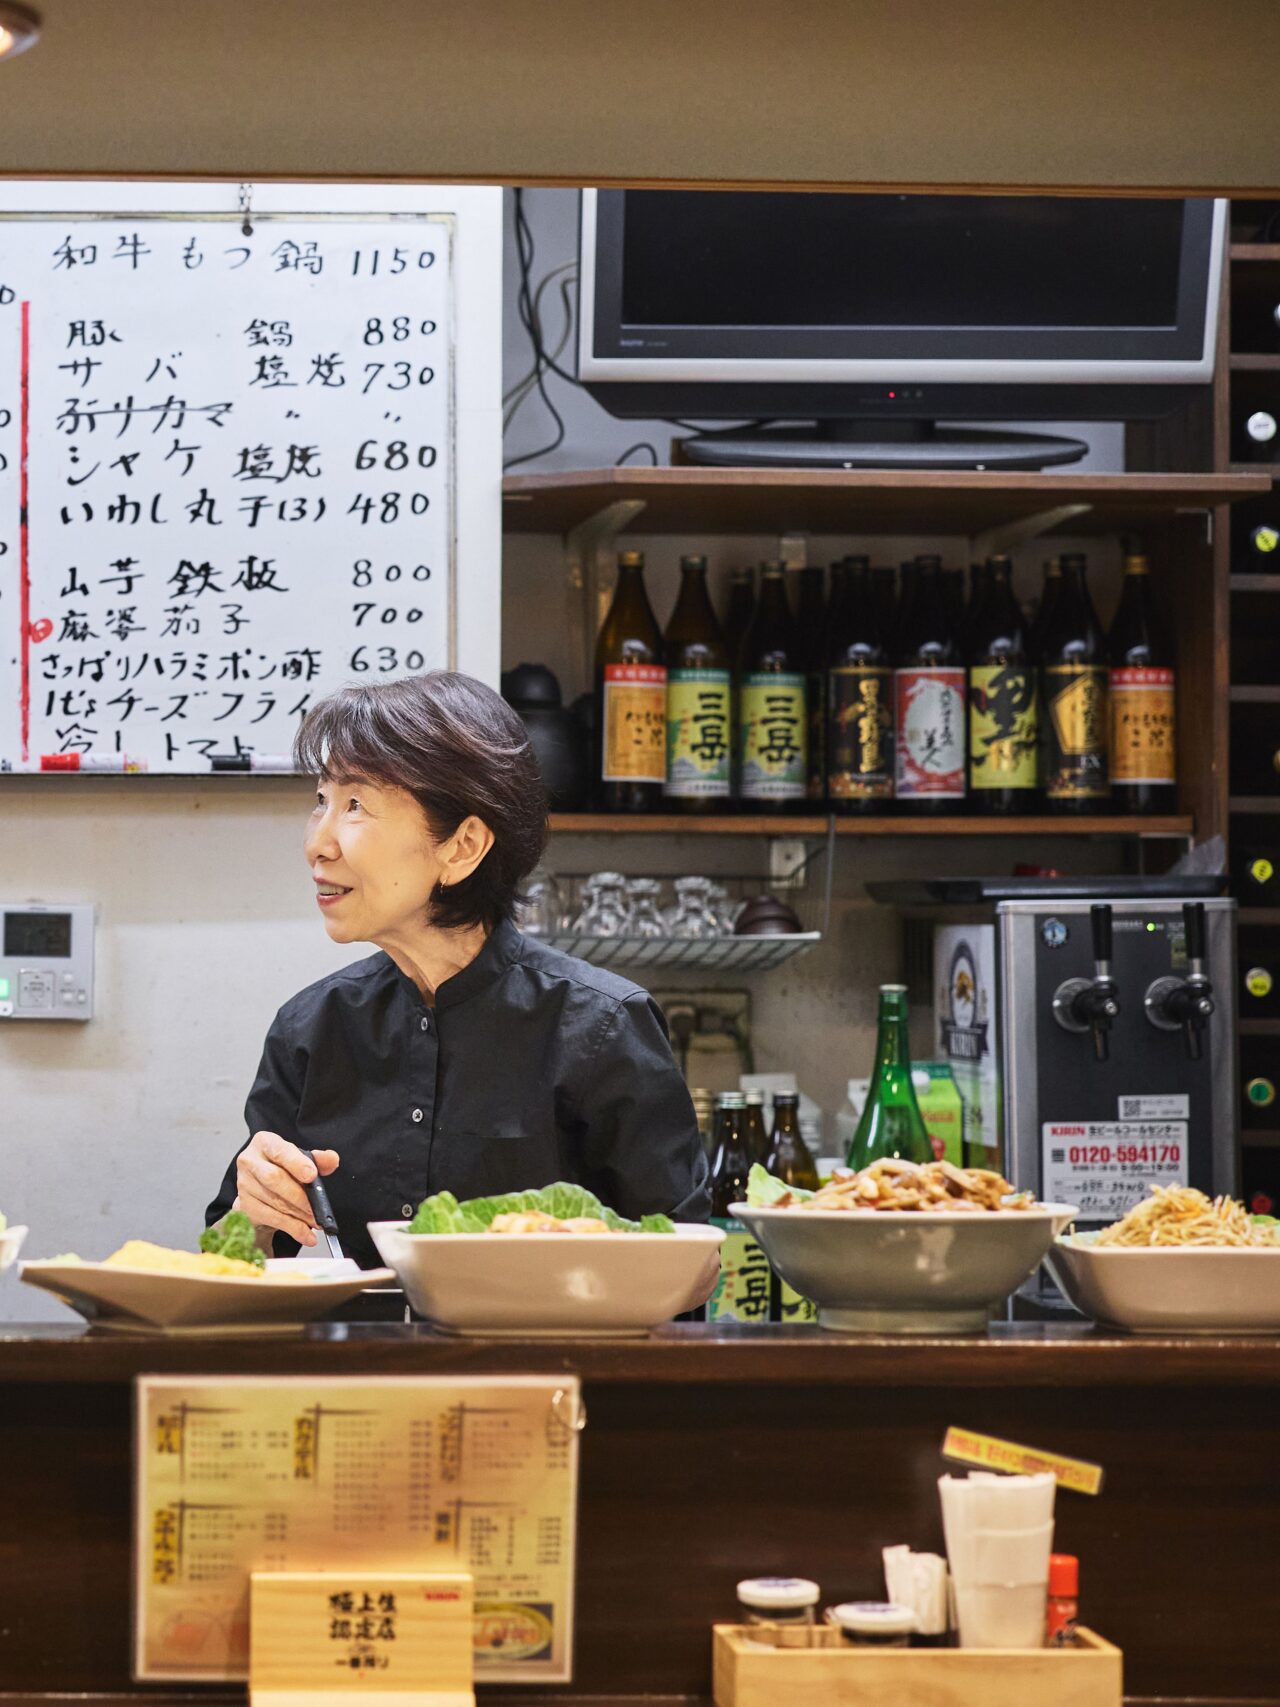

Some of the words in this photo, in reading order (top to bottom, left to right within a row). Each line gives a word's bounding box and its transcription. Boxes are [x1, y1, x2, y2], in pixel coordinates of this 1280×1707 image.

[353, 248, 435, 275] 1150
[363, 317, 436, 346] 880
[363, 362, 434, 394] 730
[355, 440, 436, 470] 680
[347, 492, 429, 524] 480
[352, 560, 431, 587] 800
[353, 603, 423, 627] 700
[350, 646, 424, 672] 630
[690, 691, 728, 762] 三岳
[758, 694, 801, 764] 三岳
